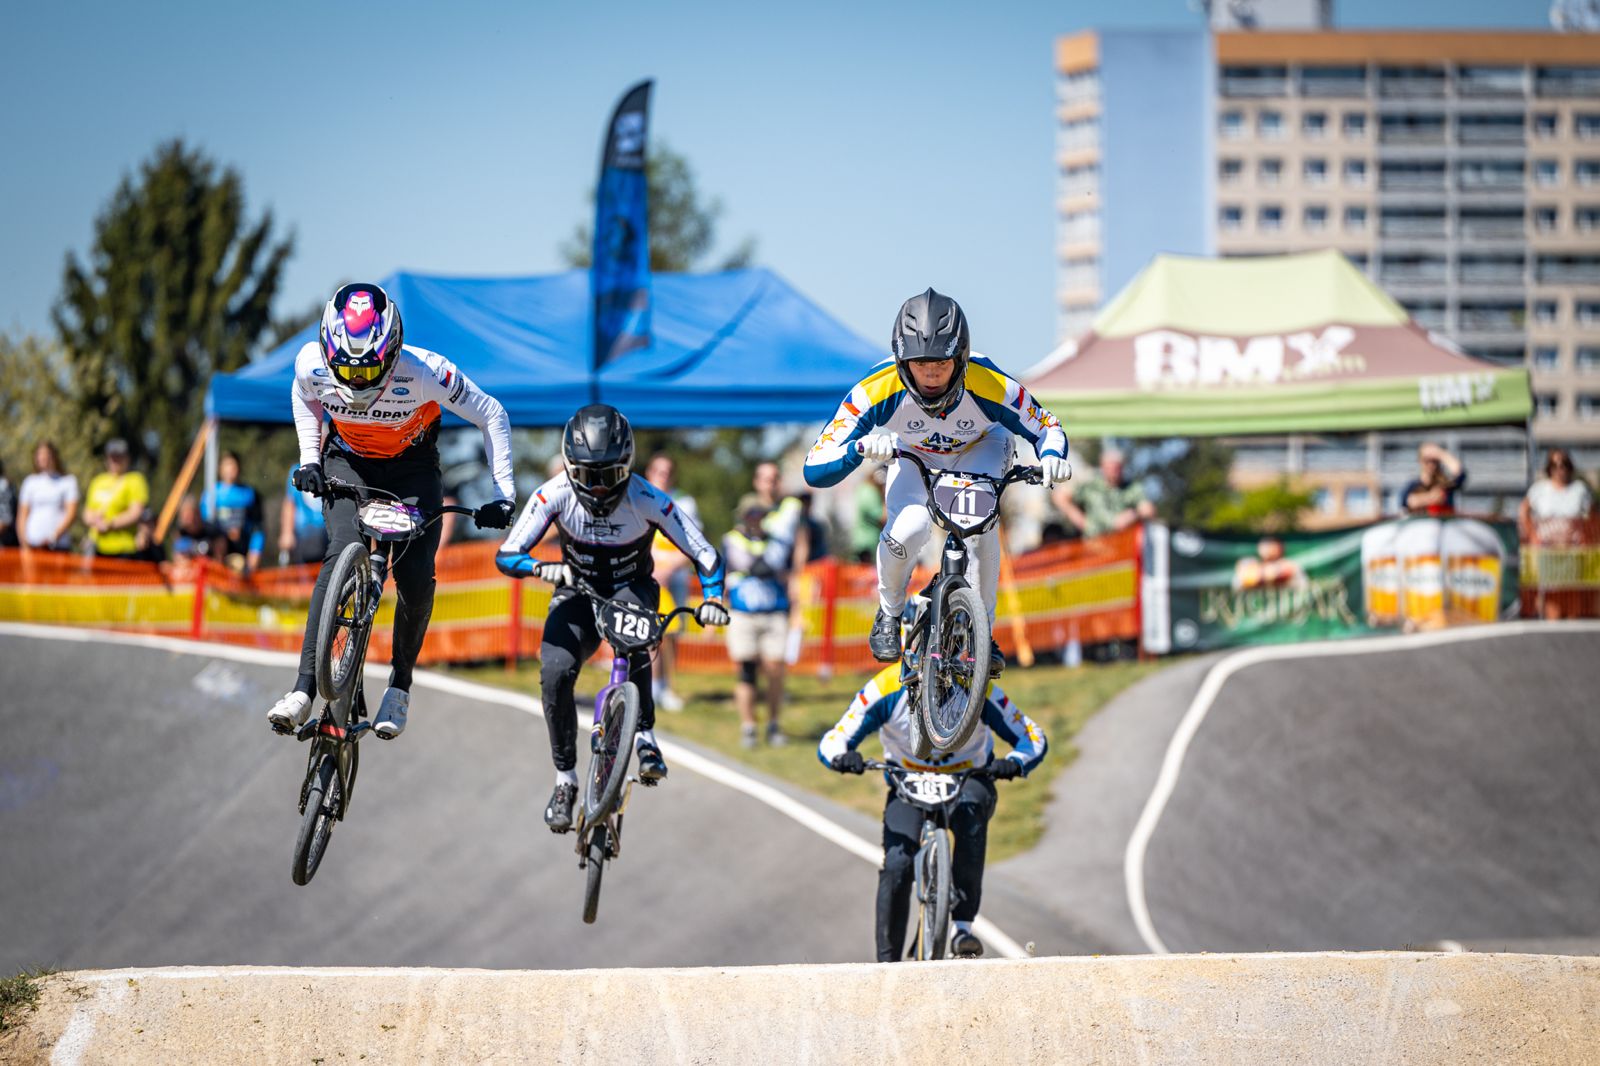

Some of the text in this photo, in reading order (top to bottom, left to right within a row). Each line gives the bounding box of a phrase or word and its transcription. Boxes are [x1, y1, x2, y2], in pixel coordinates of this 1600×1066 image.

[1134, 326, 1356, 386] BMX
[954, 489, 976, 515] 11
[363, 508, 416, 532] 125
[613, 611, 650, 640] 120
